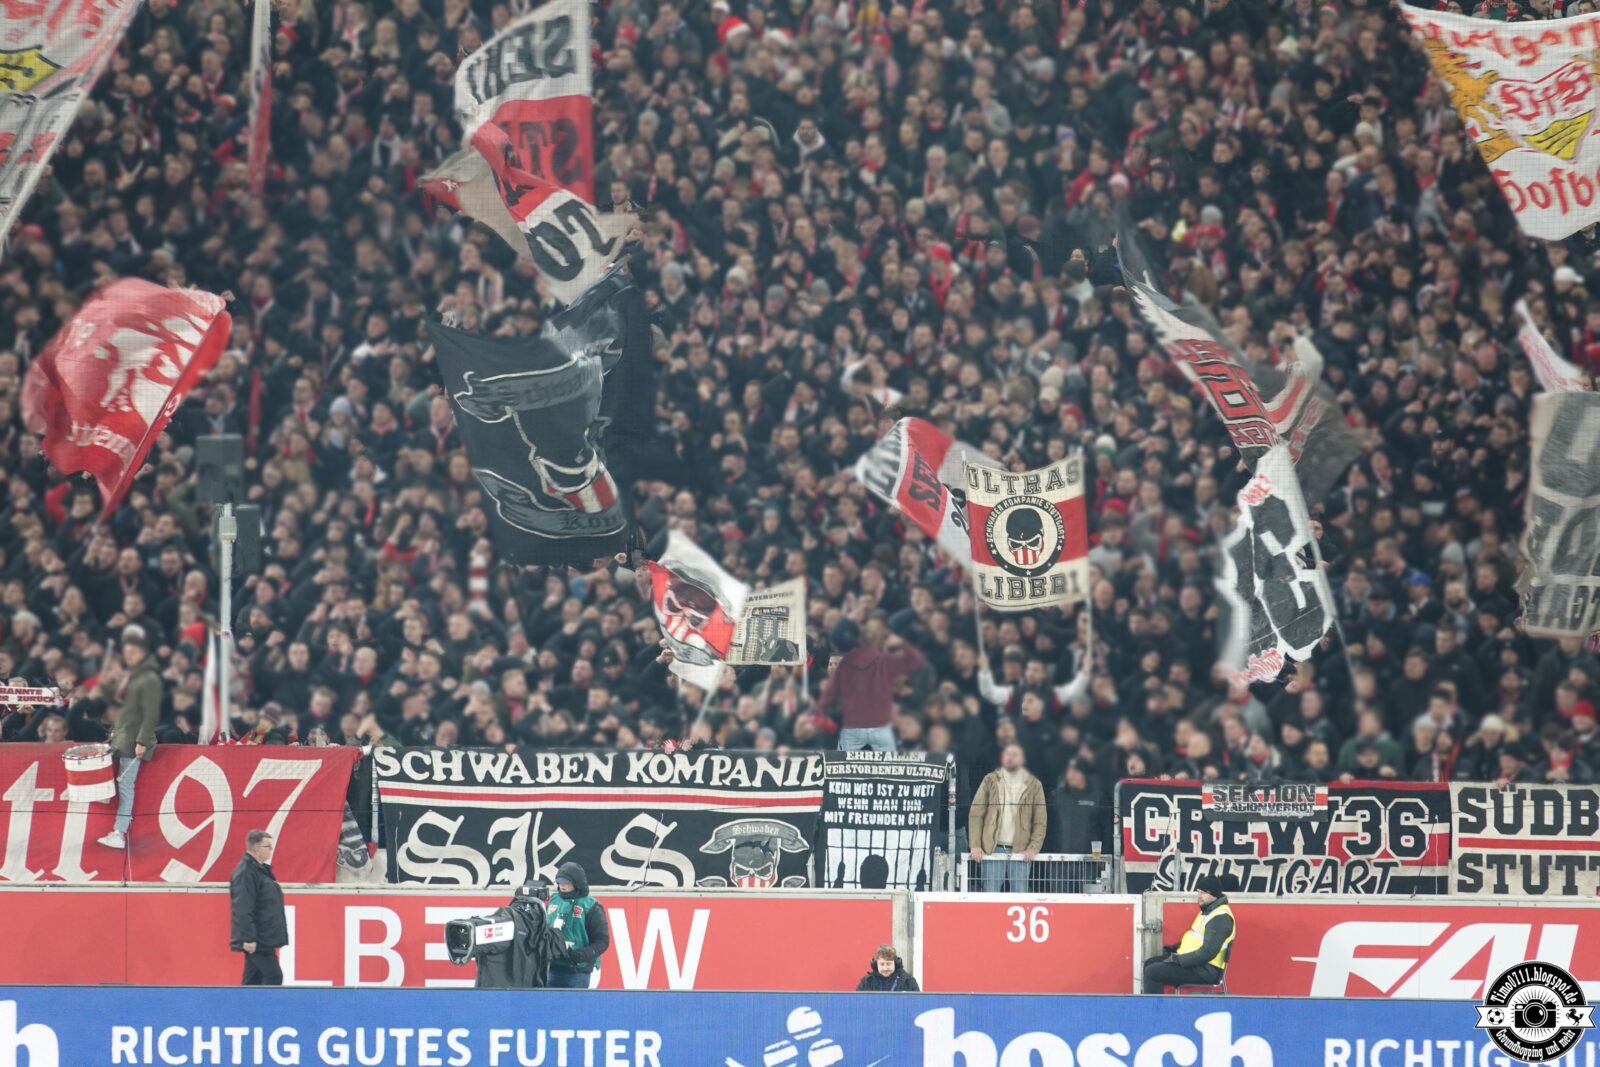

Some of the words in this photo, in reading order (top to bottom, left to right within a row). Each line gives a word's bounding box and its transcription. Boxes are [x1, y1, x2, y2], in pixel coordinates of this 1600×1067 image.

[1492, 166, 1600, 215] Hofb
[966, 459, 1081, 495] ULTRAS
[1003, 496, 1043, 508] KOMPANIE
[1043, 502, 1065, 540] STUTTGART
[978, 571, 1081, 601] LIBERI
[374, 746, 614, 784] SCHWABEN
[625, 752, 825, 788] KOMPANIE
[826, 764, 904, 776] VERSTORBENEN
[906, 765, 944, 779] ULTRAS
[846, 751, 882, 761] EHRE
[884, 751, 926, 762] ALLEN
[829, 781, 852, 795] KEIN
[854, 783, 874, 797] WEG
[877, 784, 894, 797] IST
[898, 785, 910, 797] ZU
[838, 797, 869, 810] WENN
[873, 799, 898, 811] MAN
[158, 755, 323, 882] 97
[824, 811, 845, 823] MIT
[848, 812, 905, 826] FREUNDEN
[1342, 797, 1430, 861] 36
[1005, 905, 1050, 943] 36
[112, 1026, 300, 1065] RICHTIG
[316, 1026, 472, 1067] GUTES
[490, 1029, 662, 1067] FUTTER
[914, 1007, 1275, 1067] bosch
[1324, 1037, 1511, 1067] RICHTIG
